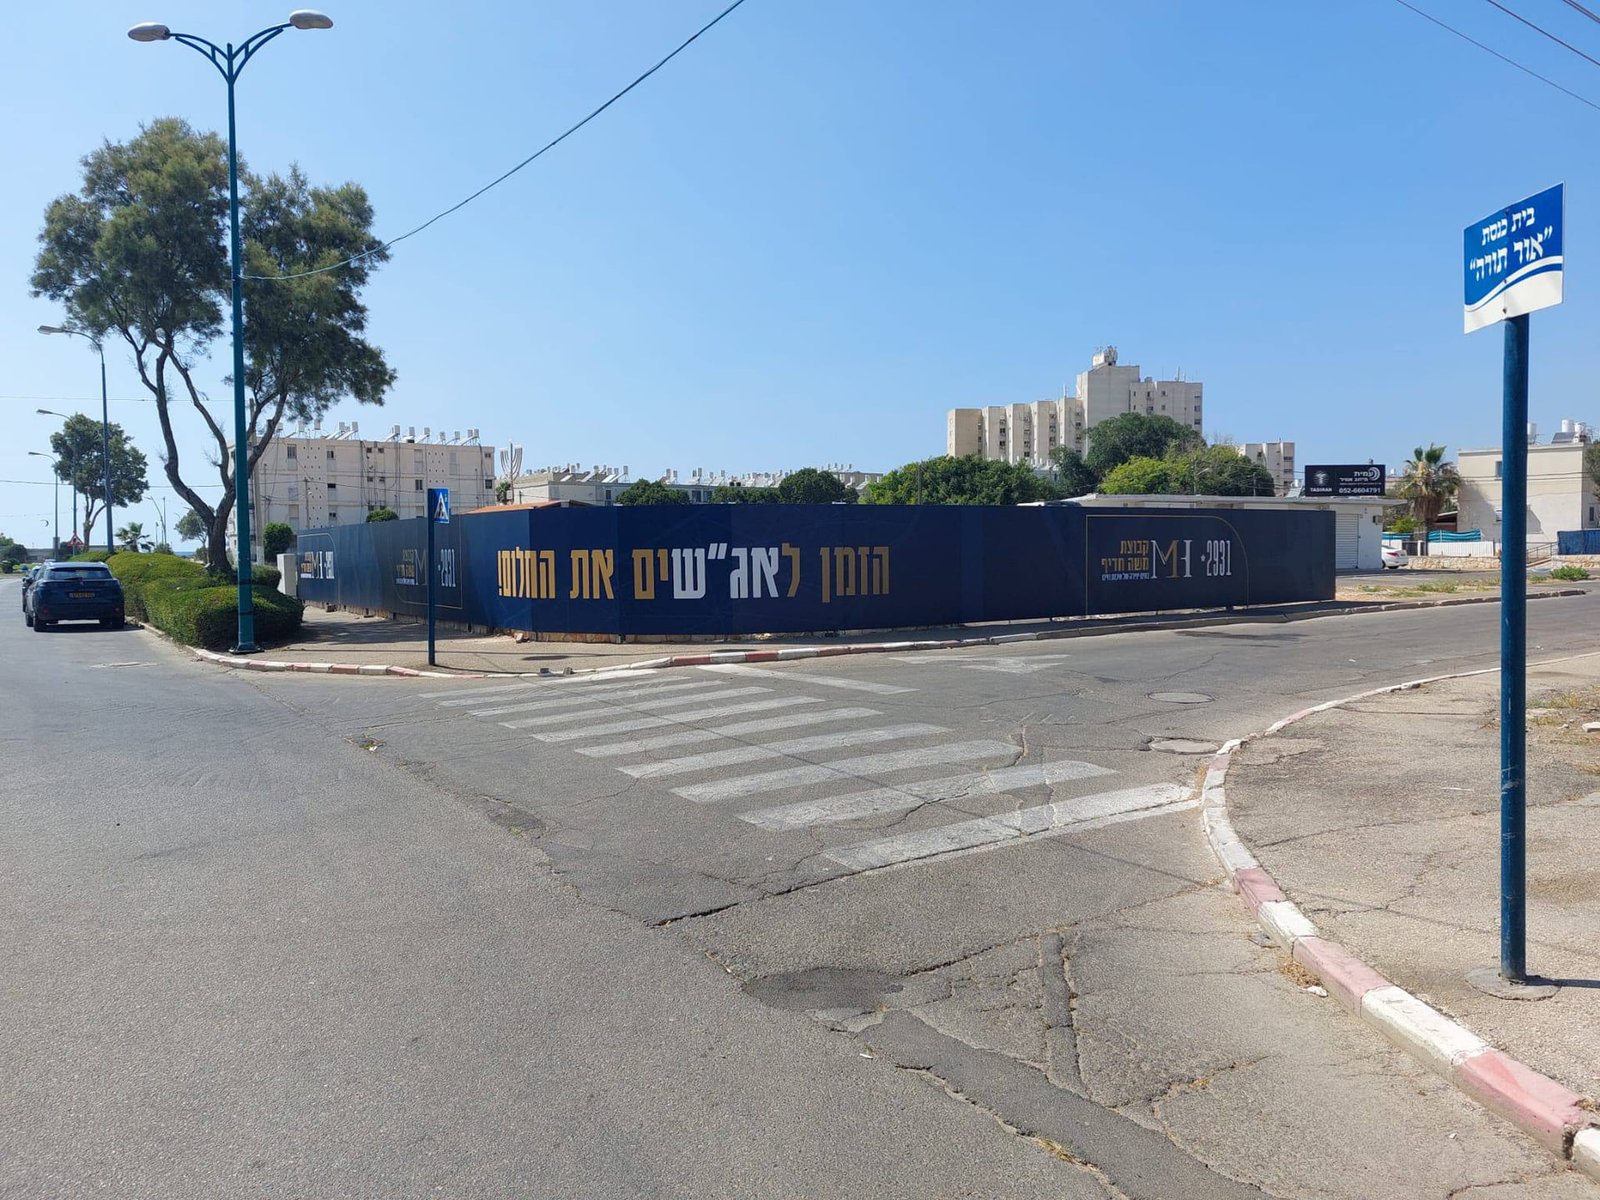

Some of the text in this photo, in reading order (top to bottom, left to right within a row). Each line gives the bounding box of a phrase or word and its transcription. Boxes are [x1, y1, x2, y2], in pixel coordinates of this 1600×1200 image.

[1481, 207, 1535, 246] בית כנסת
[1120, 540, 1149, 556] קבוצת
[1127, 557, 1149, 571] משה
[497, 546, 556, 599] החלום!
[569, 549, 614, 600] את
[820, 545, 890, 603] הזמן
